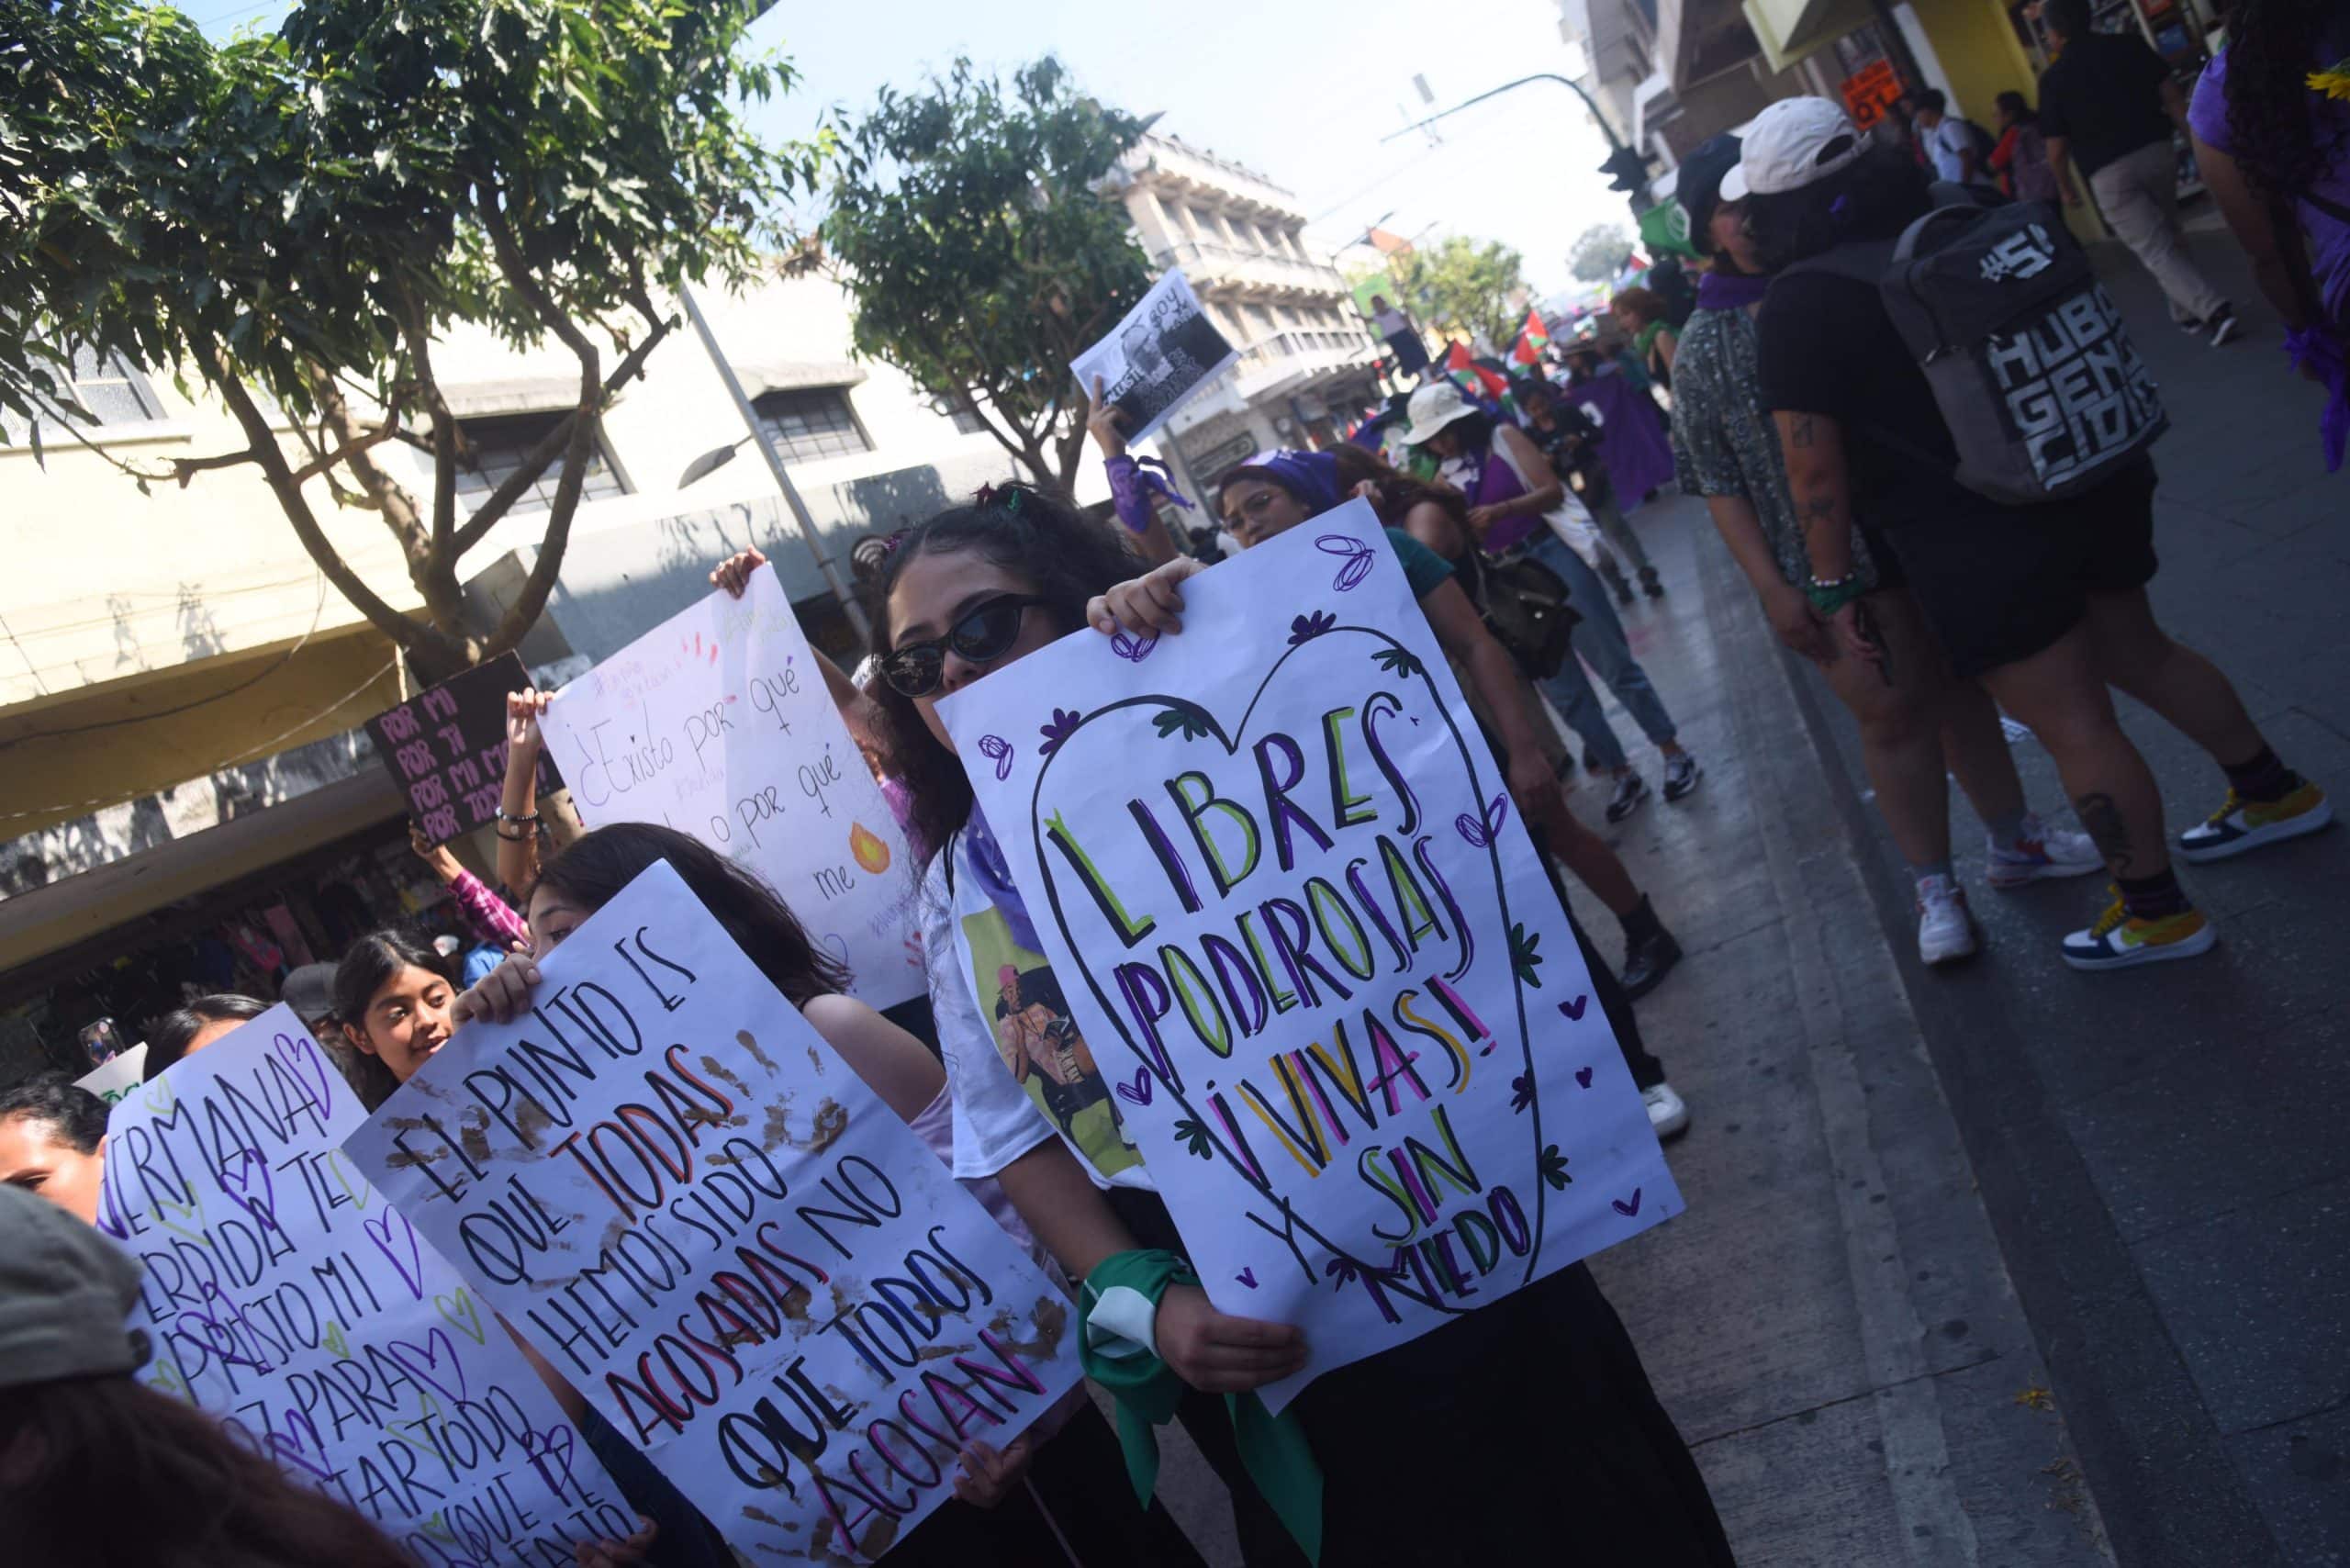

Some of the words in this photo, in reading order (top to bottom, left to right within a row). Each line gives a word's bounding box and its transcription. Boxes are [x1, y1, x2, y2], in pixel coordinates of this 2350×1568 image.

[379, 704, 420, 745] POR
[421, 687, 459, 722] MI
[396, 739, 438, 780] POR
[749, 655, 800, 737] qué
[410, 774, 449, 812] POR
[448, 758, 481, 793] MI
[422, 803, 462, 844] POR
[797, 743, 842, 819] qué
[1044, 690, 1422, 947] LIBRES
[812, 866, 856, 901] me
[1113, 834, 1475, 1095] PODEROSAS
[393, 1113, 489, 1204] EL
[462, 980, 644, 1151] PUNTO
[613, 925, 698, 1013] ES
[1205, 973, 1497, 1191] ¡VIVAS!
[458, 1173, 571, 1286] QUE
[548, 1043, 733, 1225] TODAS
[1245, 1196, 1319, 1285] Y
[1358, 1103, 1483, 1249] SIN
[139, 1196, 297, 1324] ERDIDA
[275, 1151, 354, 1232] TE
[311, 1250, 382, 1331] MI
[527, 1214, 691, 1375] HEMOS
[668, 1137, 789, 1253] SIDO
[605, 1220, 830, 1447] ACOSADAS
[795, 1155, 901, 1260] NO
[1359, 1185, 1532, 1324] MIEDO
[285, 1343, 425, 1449] PARA
[717, 1356, 860, 1499] QUE
[817, 1225, 992, 1384] TODOS
[314, 1438, 446, 1520] TAR
[404, 1385, 533, 1484] TODO
[443, 1472, 541, 1567] QUE
[526, 1441, 604, 1507] TE
[813, 1329, 1047, 1555] ACOSAN
